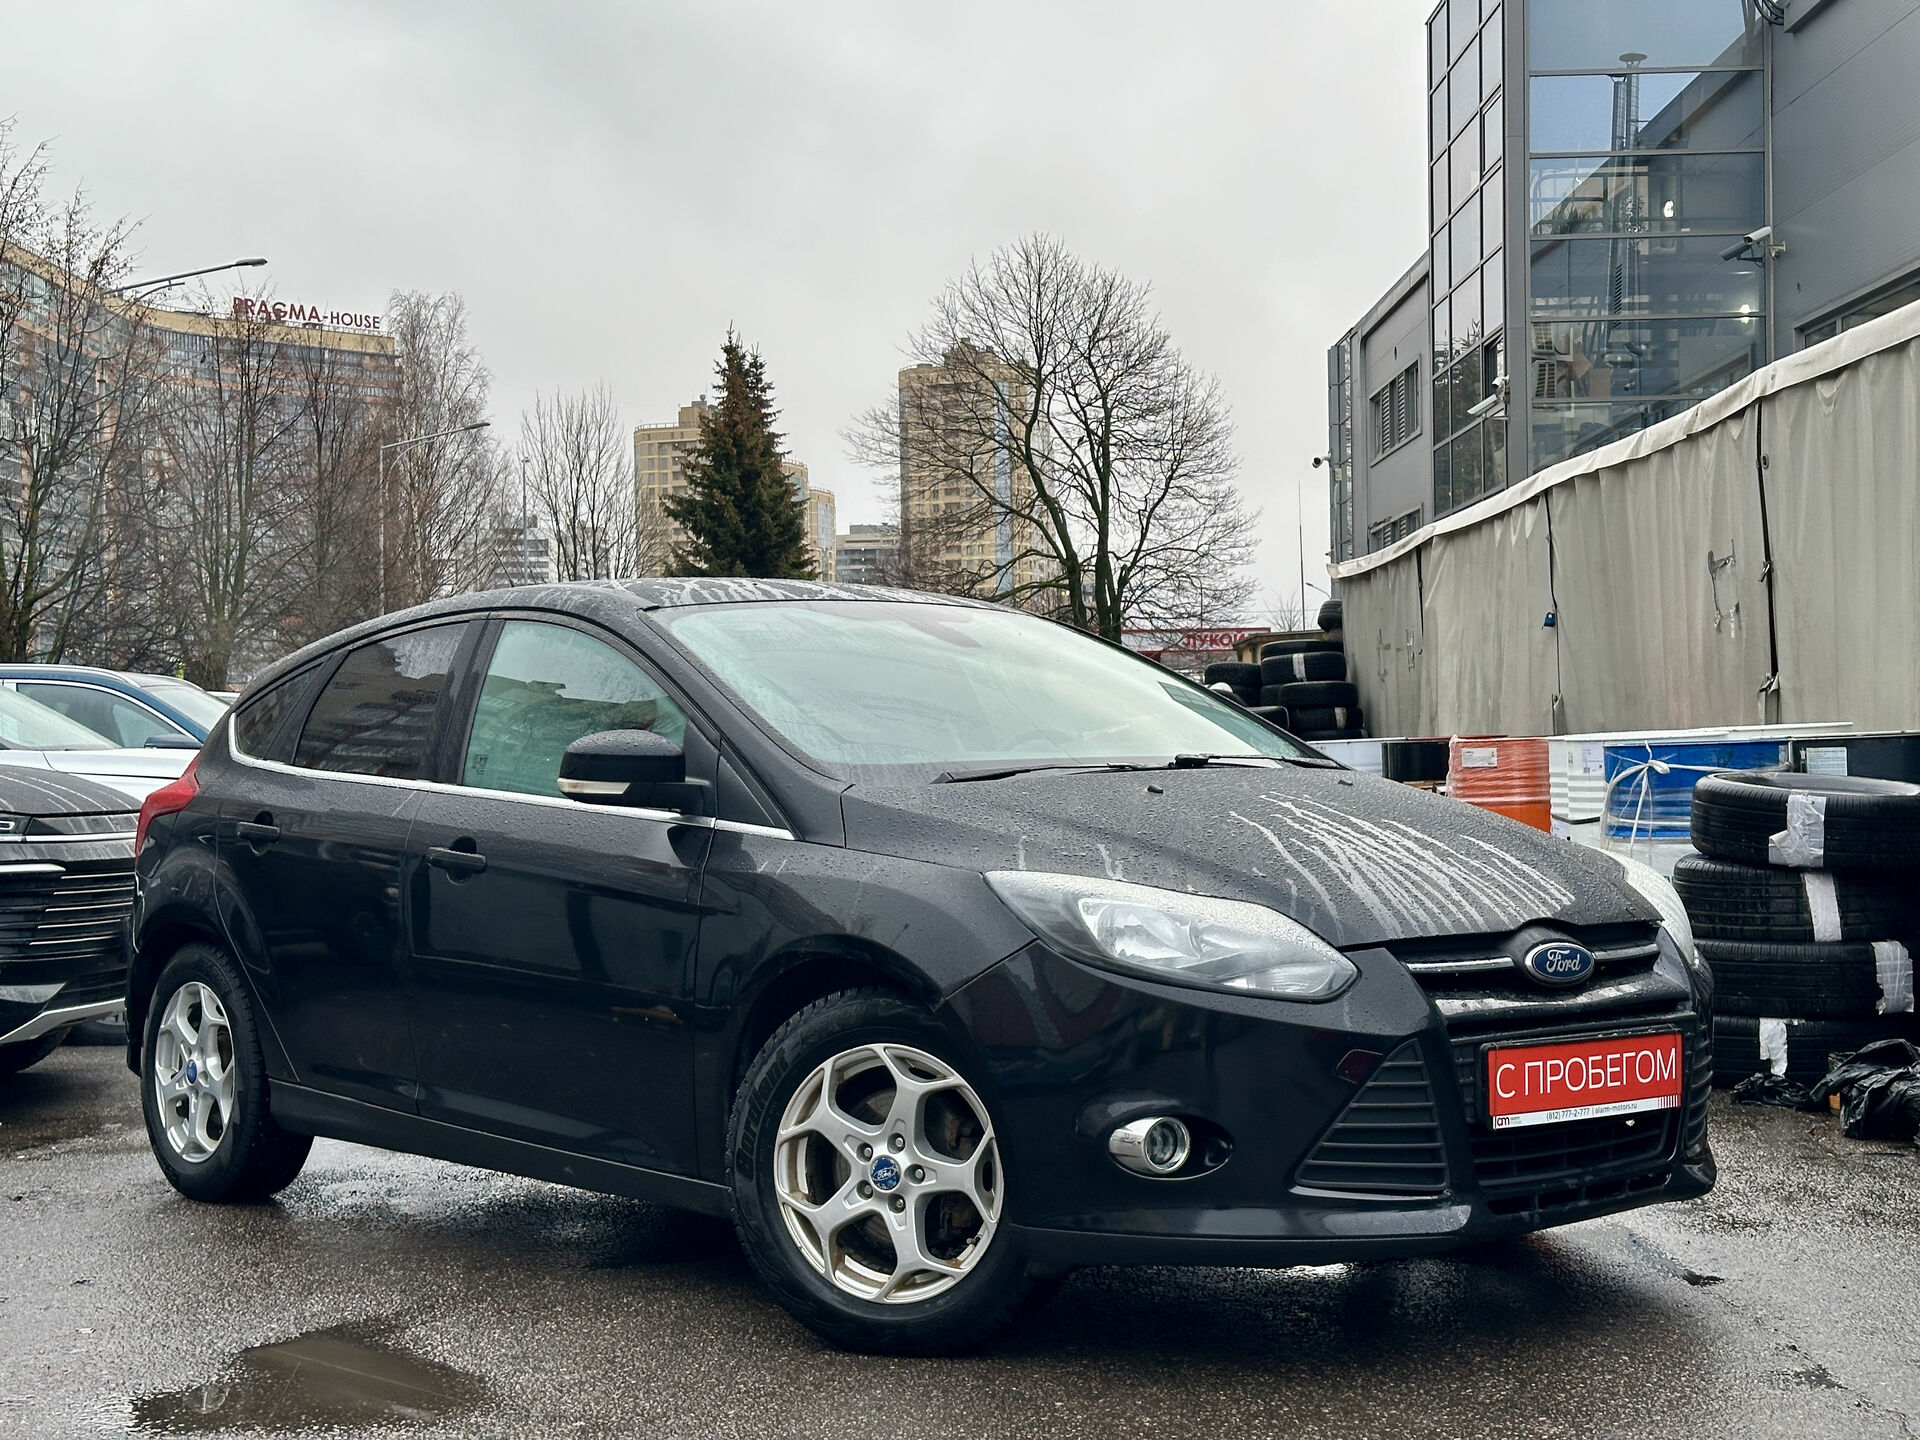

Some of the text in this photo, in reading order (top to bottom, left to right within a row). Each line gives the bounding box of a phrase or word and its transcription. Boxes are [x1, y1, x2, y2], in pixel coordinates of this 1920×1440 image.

[233, 297, 380, 329] PRAGMA-HOUSE
[1184, 630, 1254, 647] ЛУКОЙ
[1546, 949, 1581, 973] Ford
[1496, 1047, 1676, 1098] С ПРОБЕГОМ
[1546, 1103, 1638, 1121] (812) 777-2-777 alarm-motors.ru
